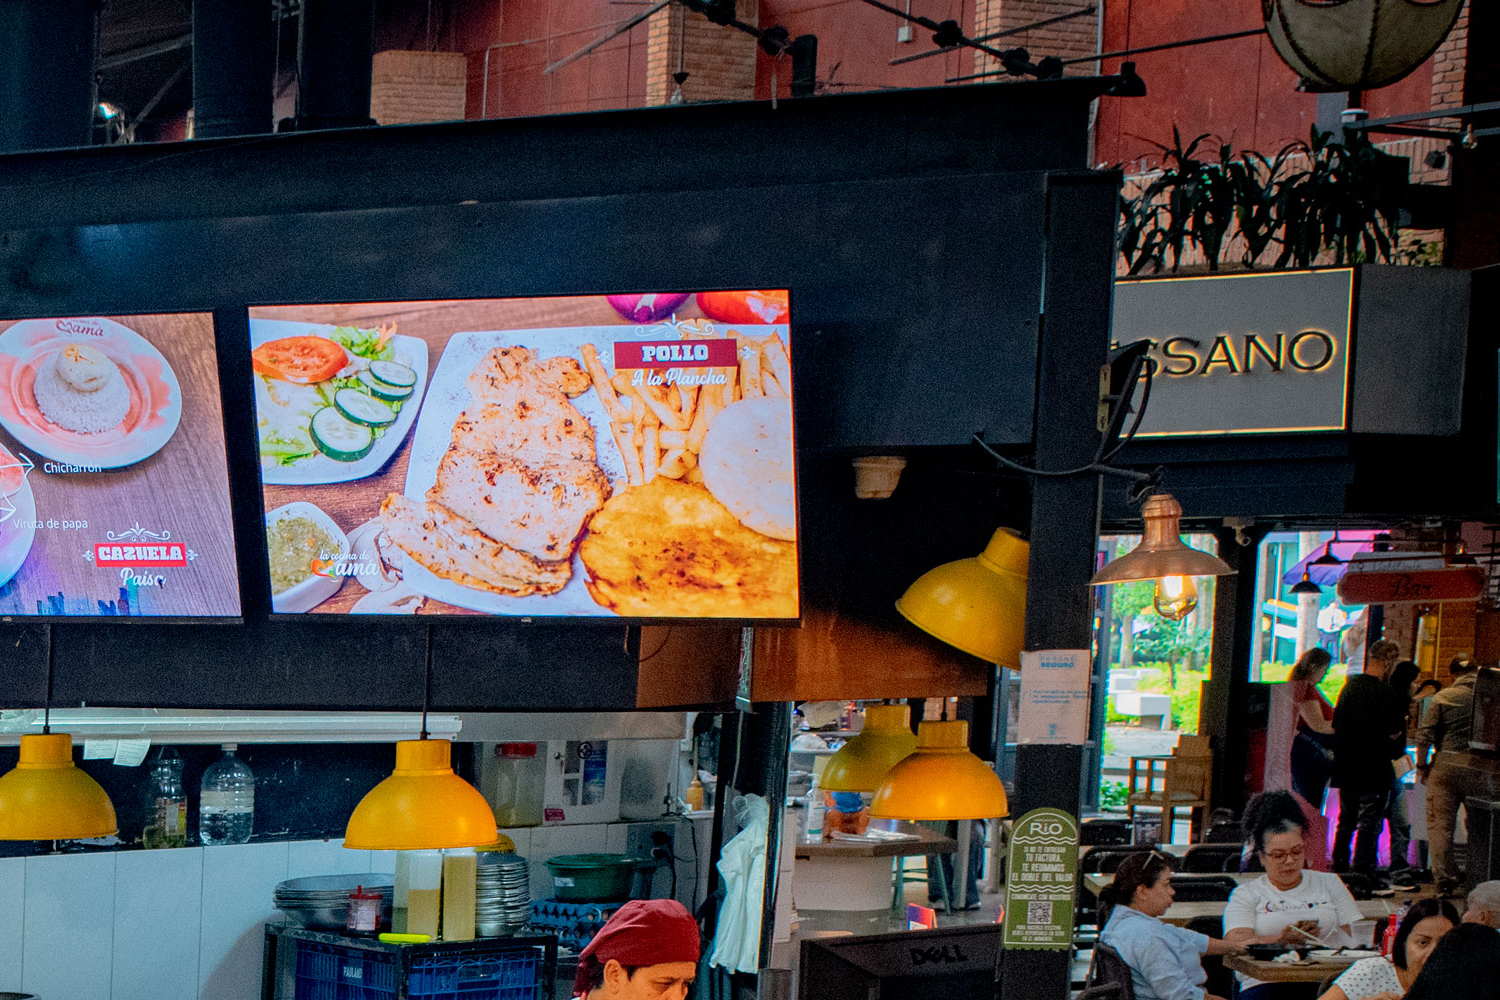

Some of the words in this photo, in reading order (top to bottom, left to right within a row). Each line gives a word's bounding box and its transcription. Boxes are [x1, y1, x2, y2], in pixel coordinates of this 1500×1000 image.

[641, 344, 709, 362] POLLO
[631, 369, 645, 387] A
[647, 369, 664, 386] la
[665, 367, 729, 387] Plancha
[13, 518, 44, 529] Viruta
[46, 518, 60, 529] de
[62, 519, 88, 532] papa
[98, 546, 184, 561] CAZUELA
[319, 550, 329, 560] la
[330, 551, 358, 560] cocina
[120, 567, 167, 586] Paisa
[909, 944, 968, 966] DELL
